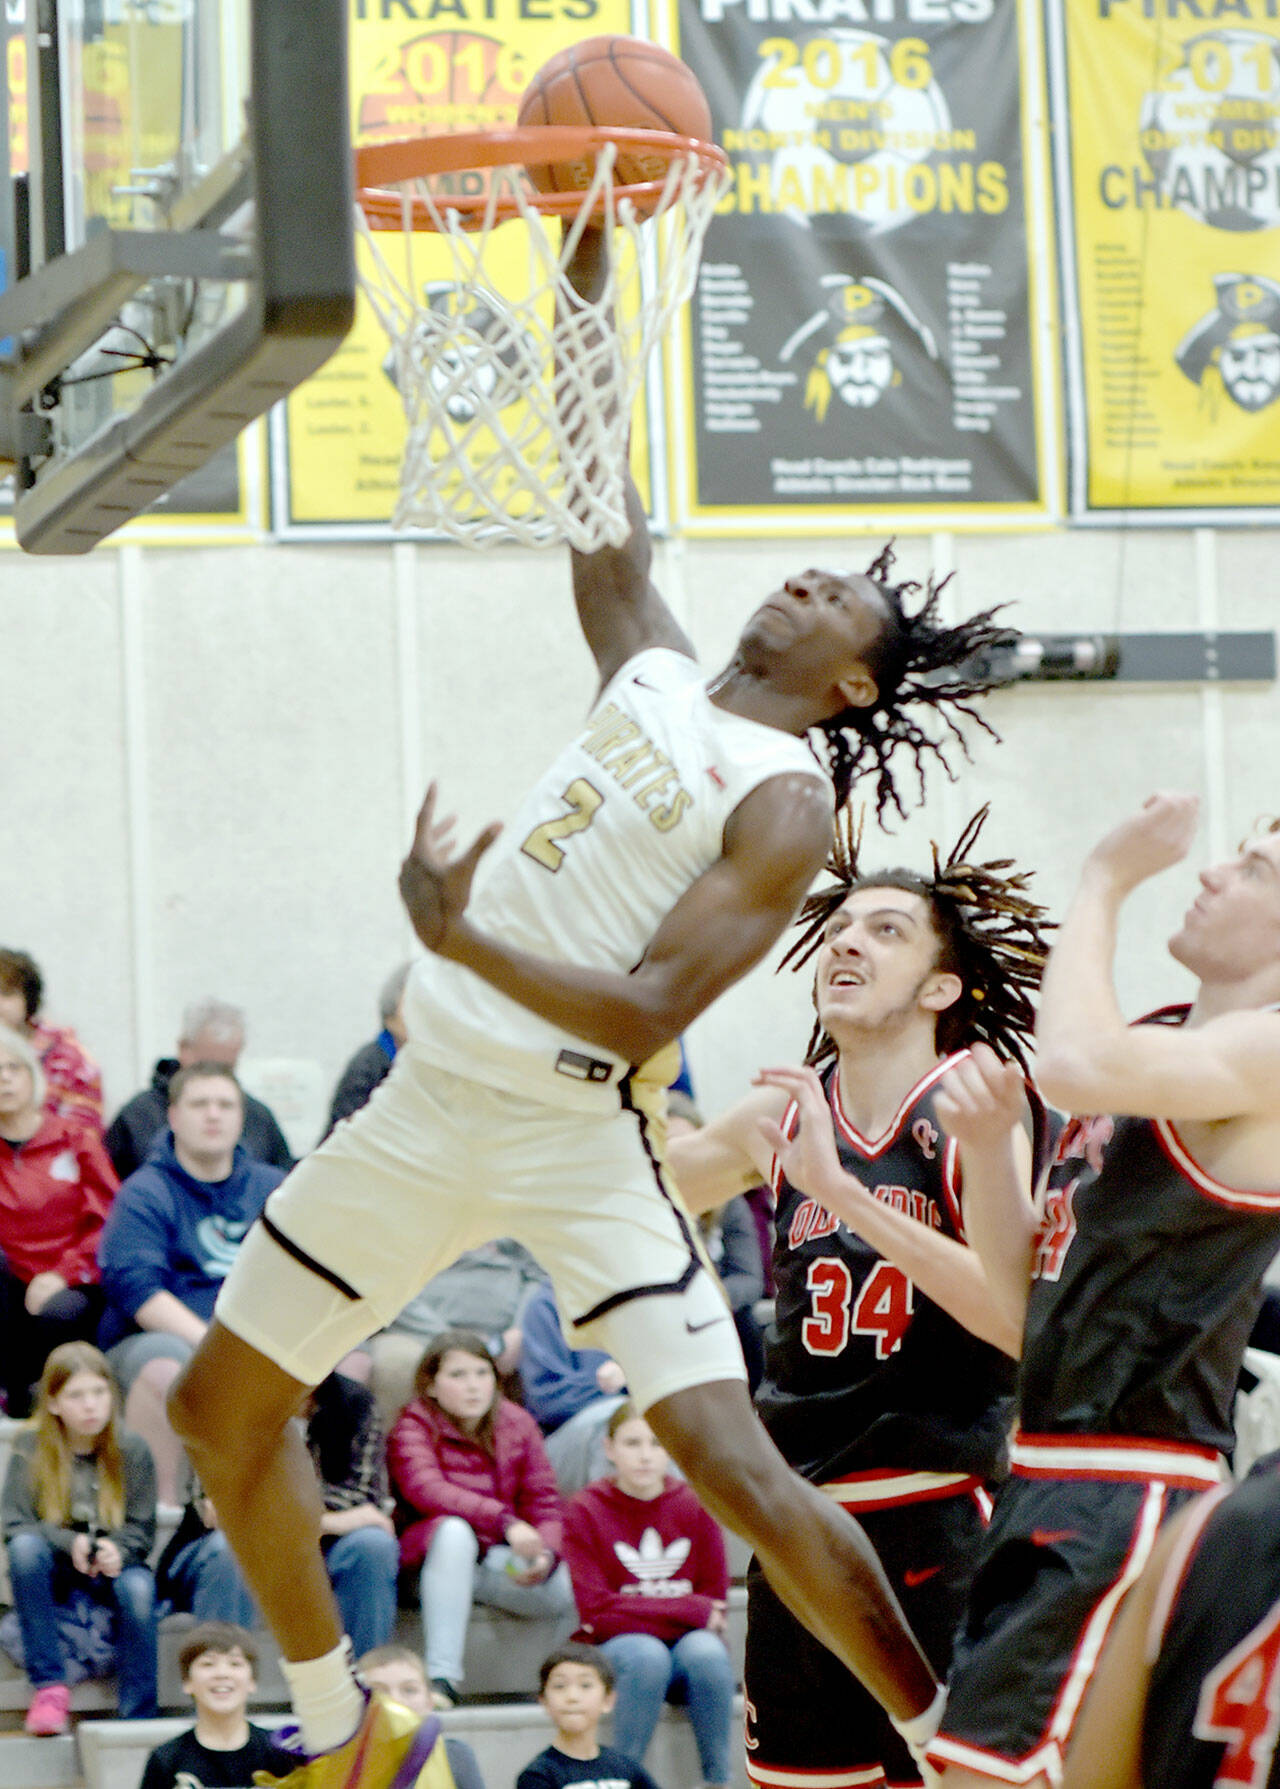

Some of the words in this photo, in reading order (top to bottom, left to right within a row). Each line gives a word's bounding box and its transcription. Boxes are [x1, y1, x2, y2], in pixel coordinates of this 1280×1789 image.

[354, 0, 600, 20] IRATES
[757, 36, 934, 90] 2016
[520, 776, 606, 874] 2
[802, 1256, 915, 1361] 34
